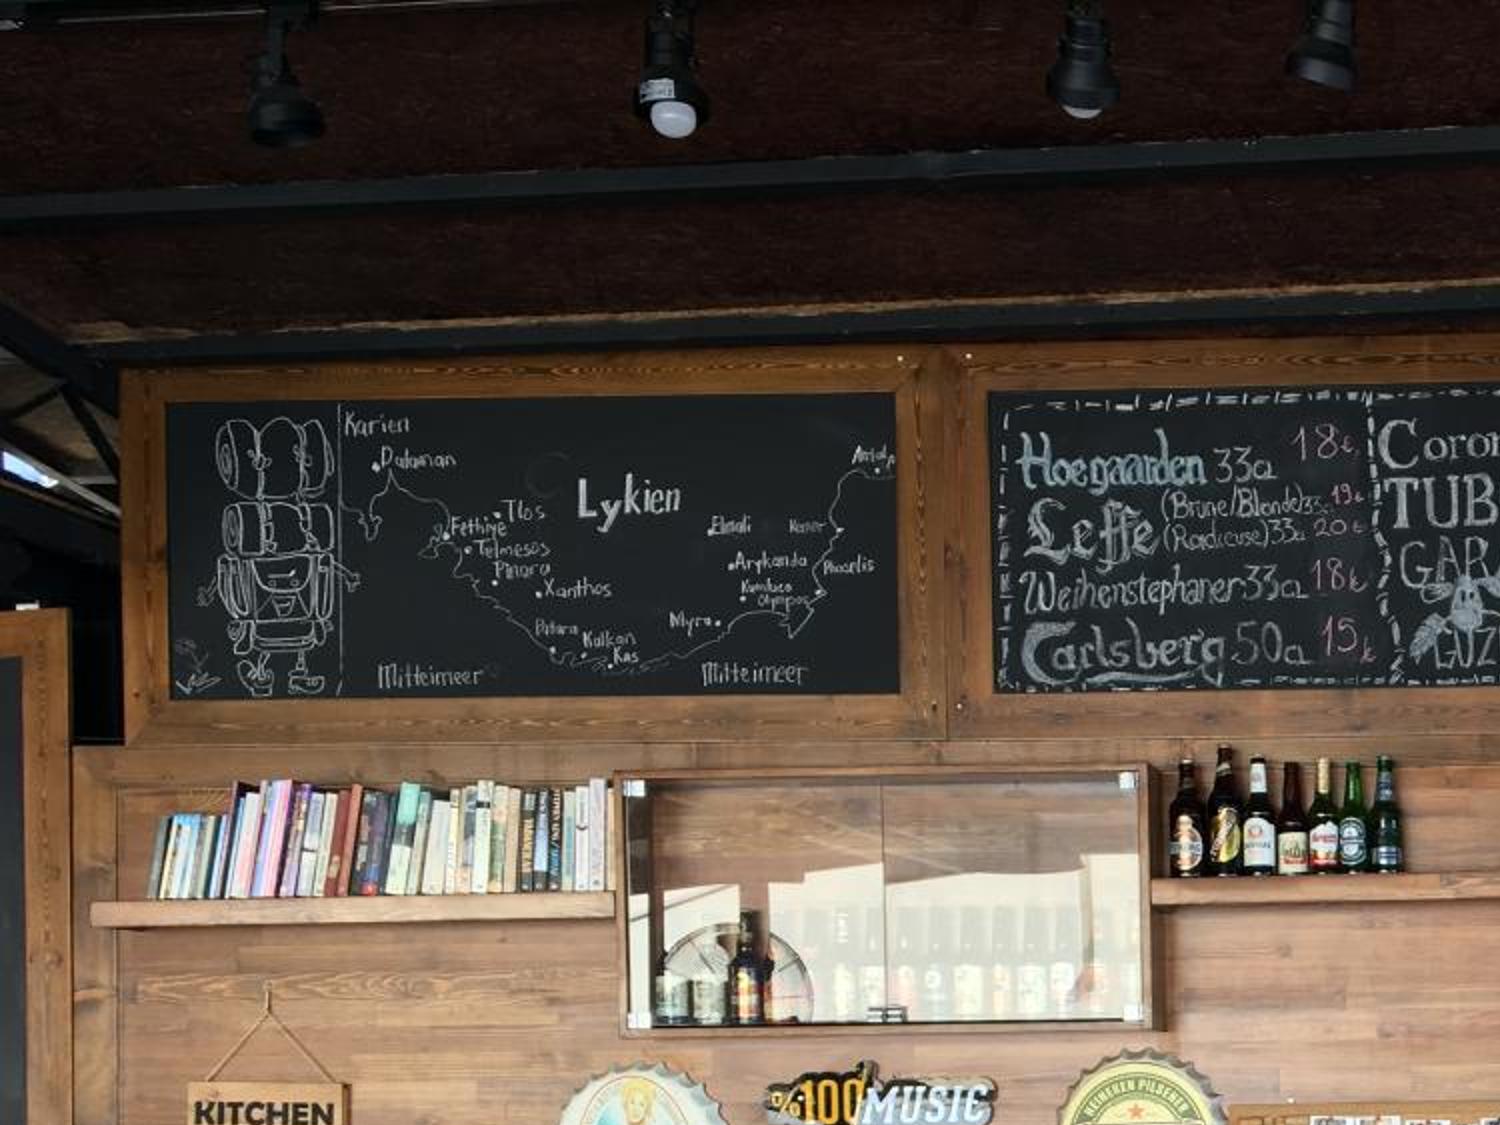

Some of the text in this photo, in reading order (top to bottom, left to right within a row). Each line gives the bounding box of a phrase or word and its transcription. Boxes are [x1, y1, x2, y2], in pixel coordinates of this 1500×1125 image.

[1015, 427, 1208, 496] Hoegaarden
[578, 473, 681, 533] Lykien
[1023, 497, 1161, 575] Leffe
[543, 576, 613, 597] Xanthos
[1018, 562, 1246, 616] Weihenstephaner
[1021, 616, 1226, 688] Carlsberg
[1083, 1078, 1191, 1117] HEINEKEN PILSENER
